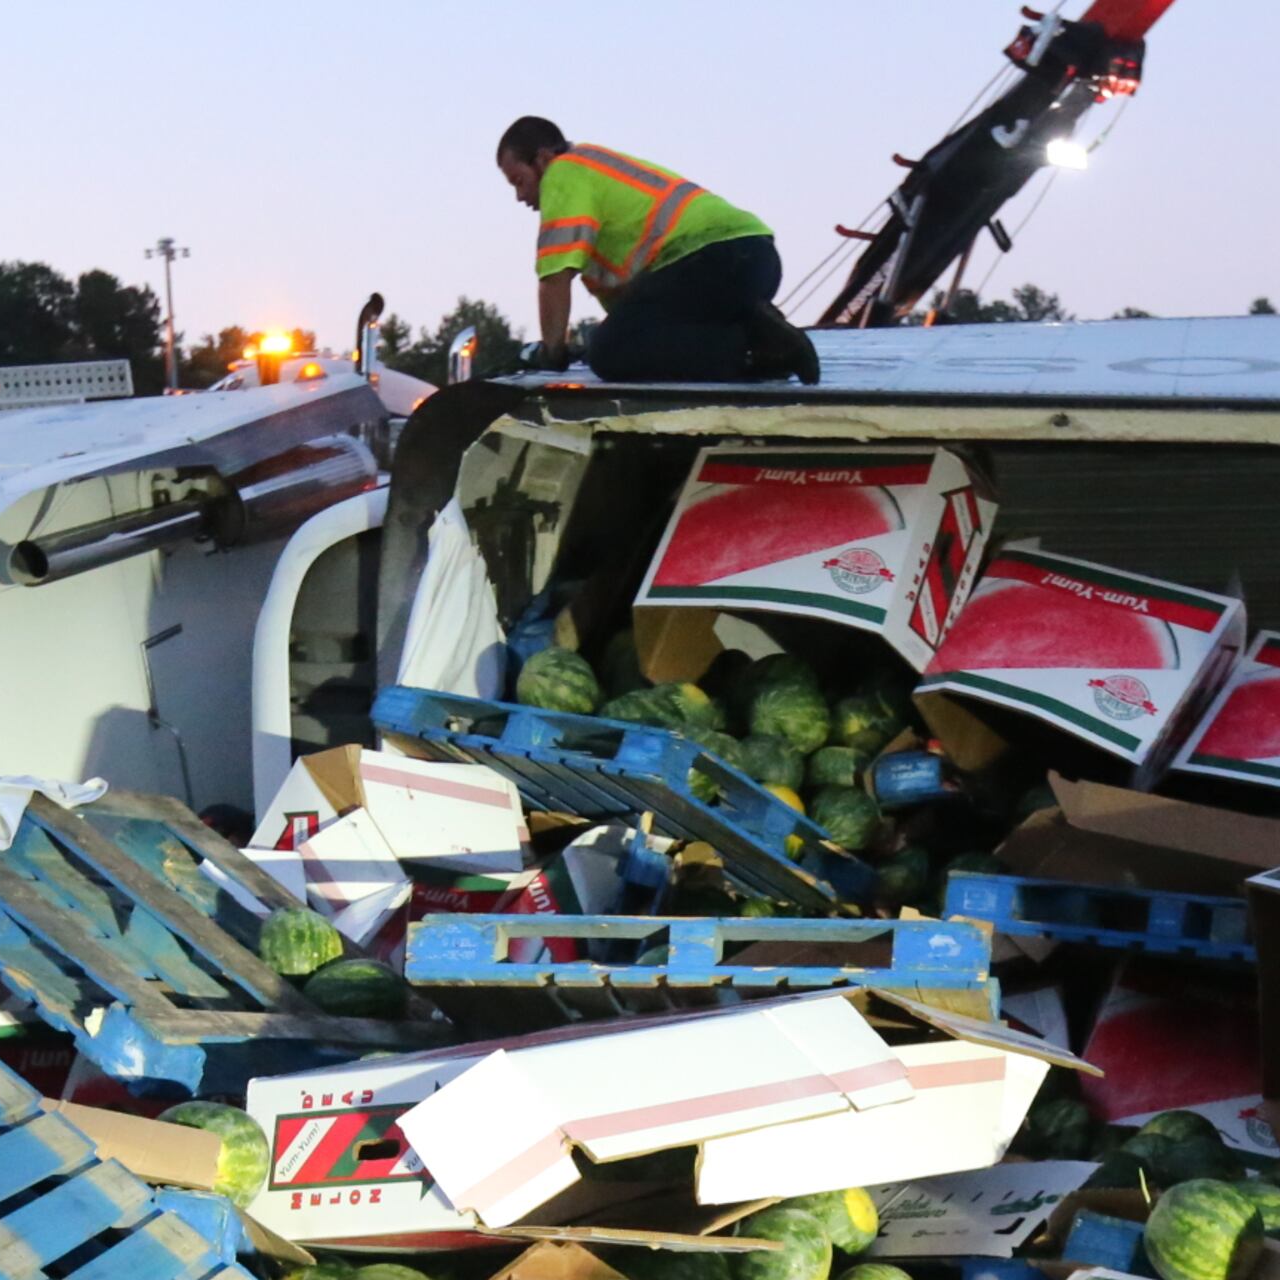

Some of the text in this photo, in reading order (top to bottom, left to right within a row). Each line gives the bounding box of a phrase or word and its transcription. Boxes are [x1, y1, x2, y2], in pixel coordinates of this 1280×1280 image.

[754, 467, 864, 485] Yum-Yum!
[1040, 572, 1150, 614] Yum-Yum!
[300, 1089, 375, 1109] D'EAU
[278, 1122, 322, 1178] Yum-Yum!
[290, 1188, 382, 1210] MELON
